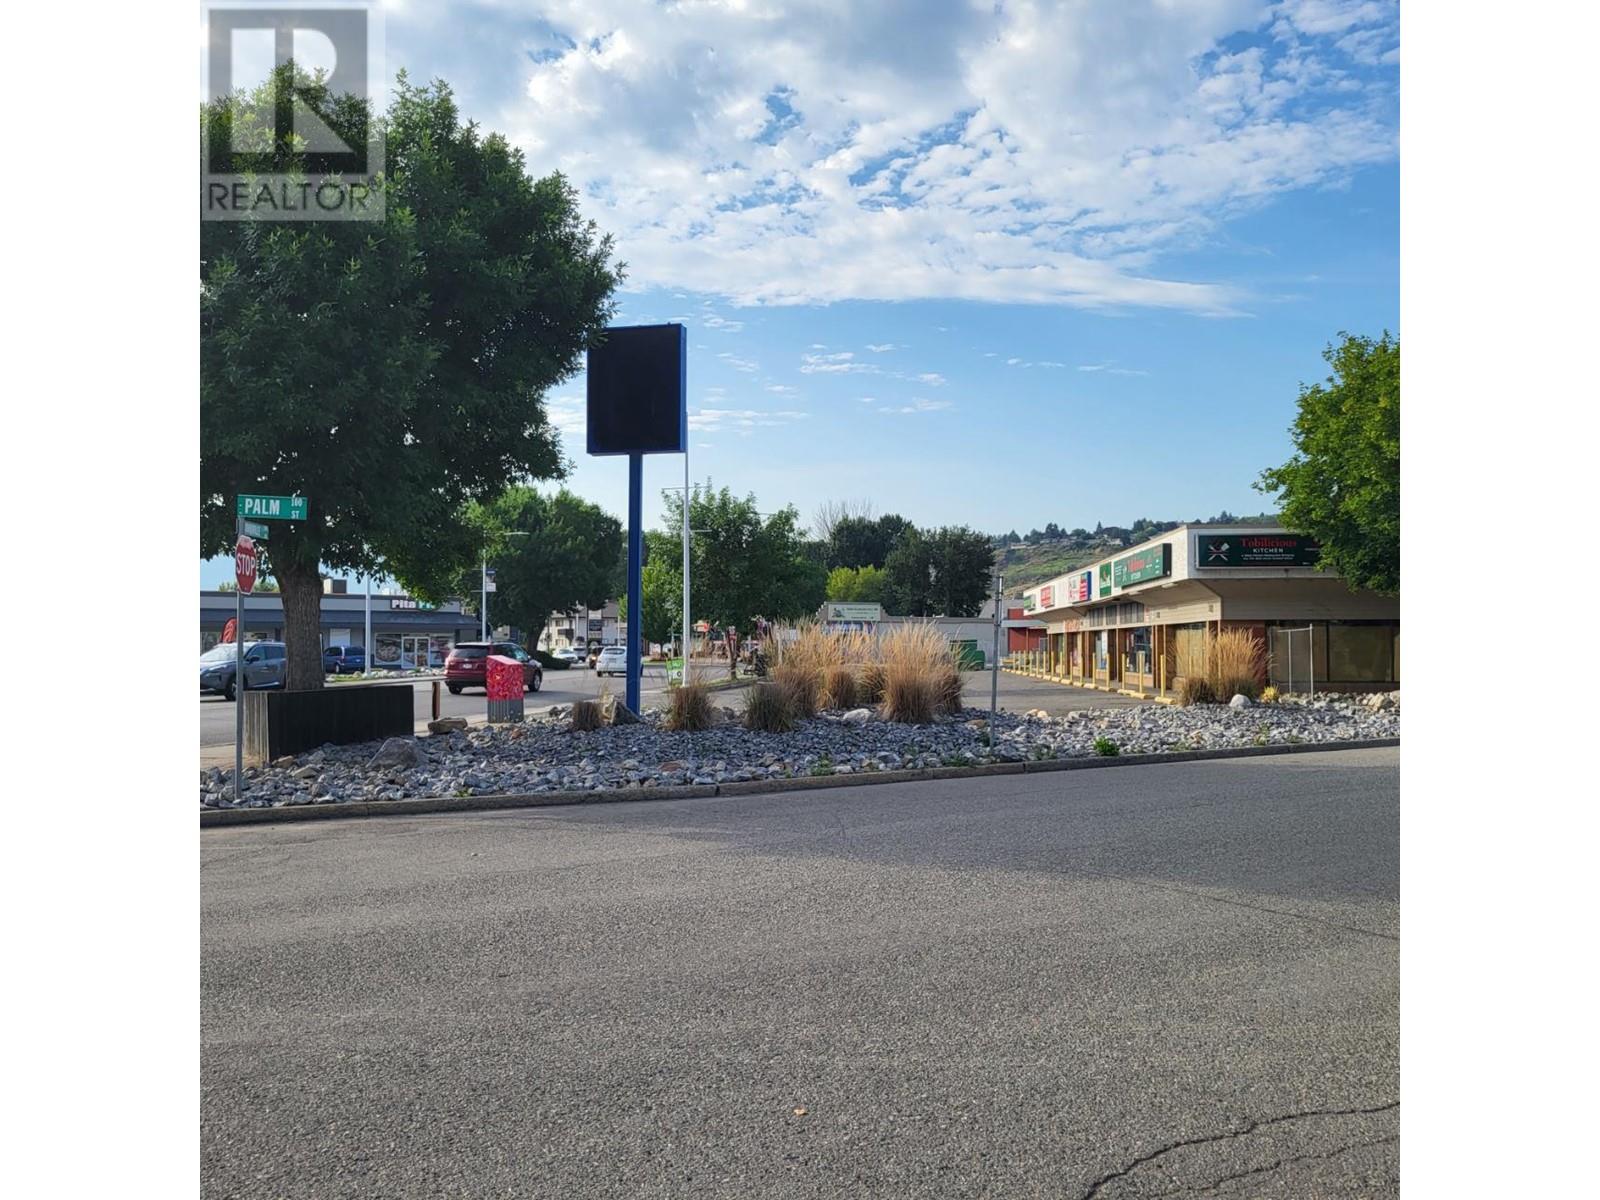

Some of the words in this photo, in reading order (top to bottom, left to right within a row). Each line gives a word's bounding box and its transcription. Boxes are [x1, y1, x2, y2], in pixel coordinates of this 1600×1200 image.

[244, 498, 280, 515] PALM
[291, 497, 303, 507] 100
[291, 510, 300, 519] ST
[236, 553, 256, 577] STOP
[391, 599, 416, 609] Pita
